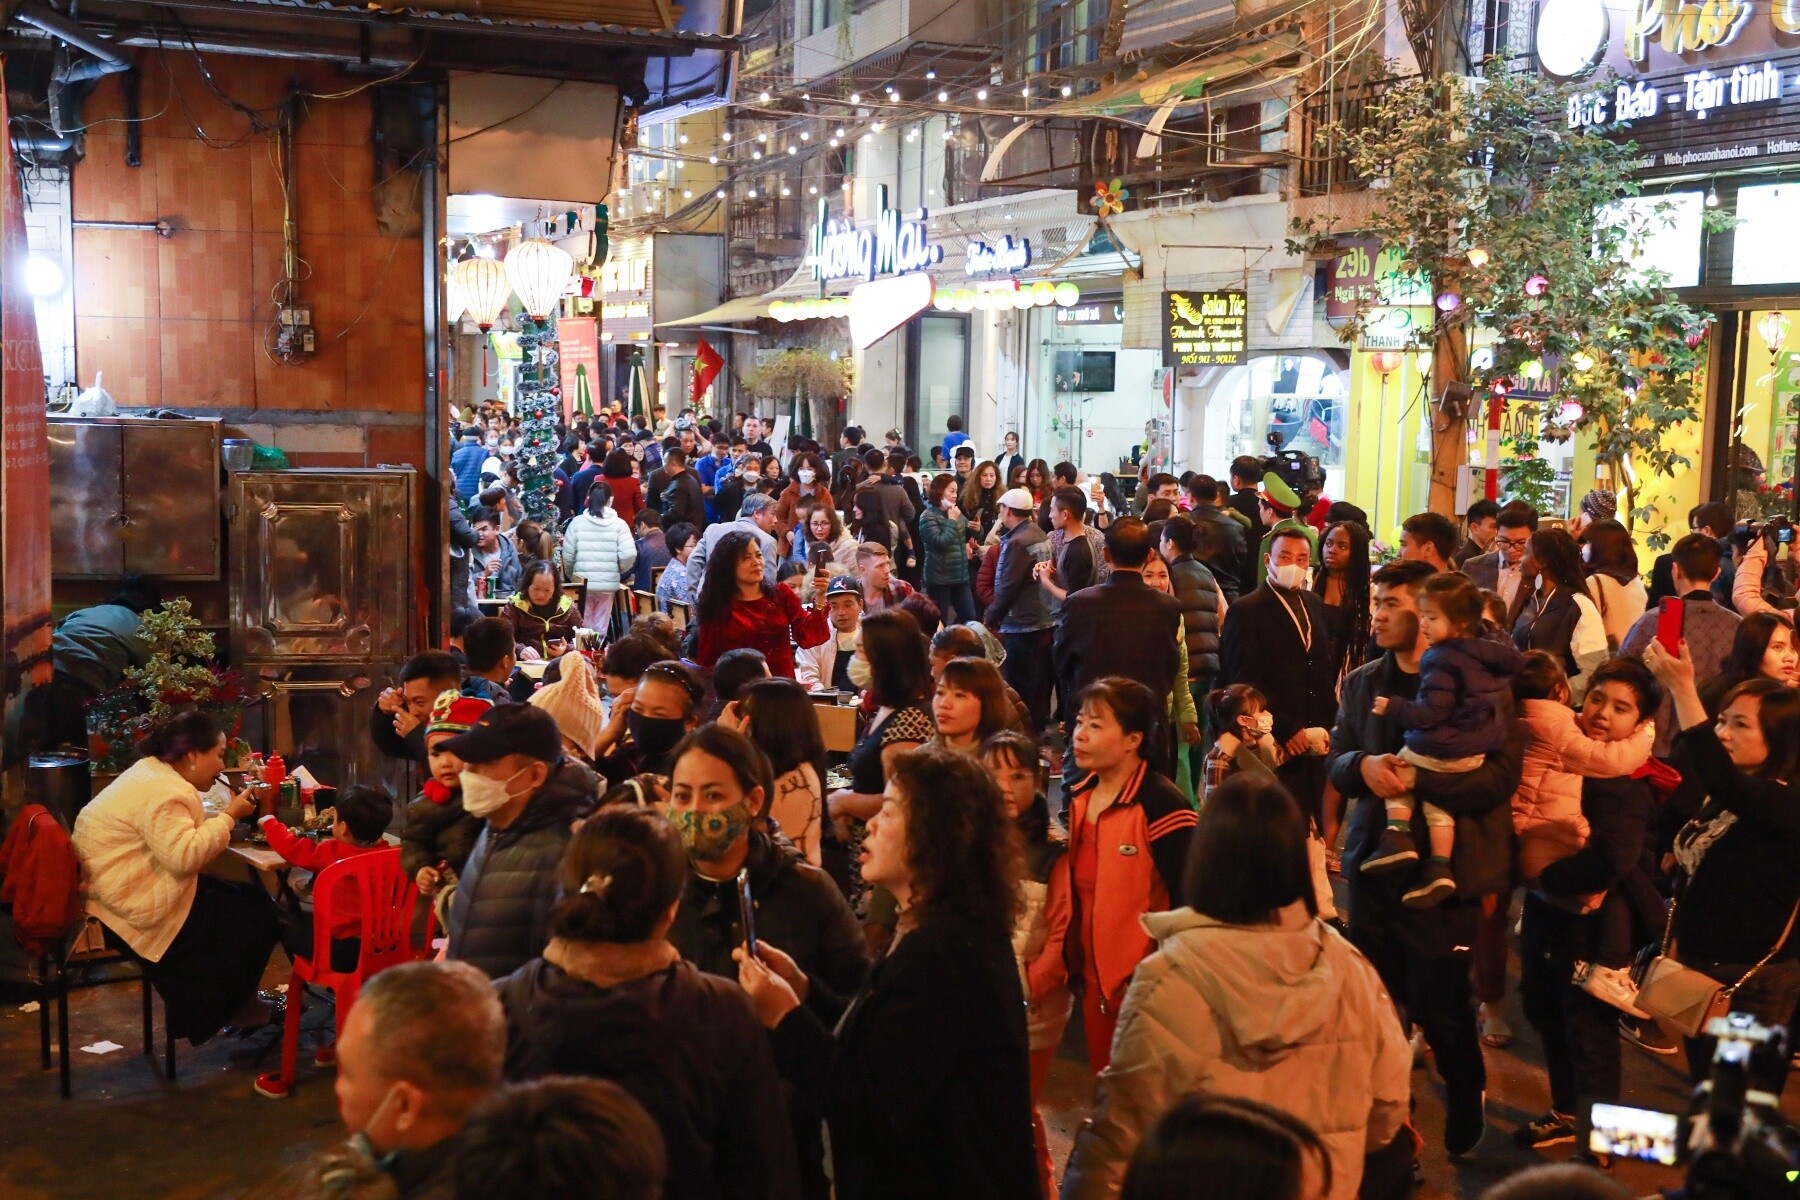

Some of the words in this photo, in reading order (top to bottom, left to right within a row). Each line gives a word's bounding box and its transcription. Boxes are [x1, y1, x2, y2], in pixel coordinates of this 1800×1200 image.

[1684, 70, 1725, 119] Tận
[1731, 61, 1779, 104] tình
[1170, 326, 1205, 339] Thanh
[1366, 335, 1400, 347] THANH
